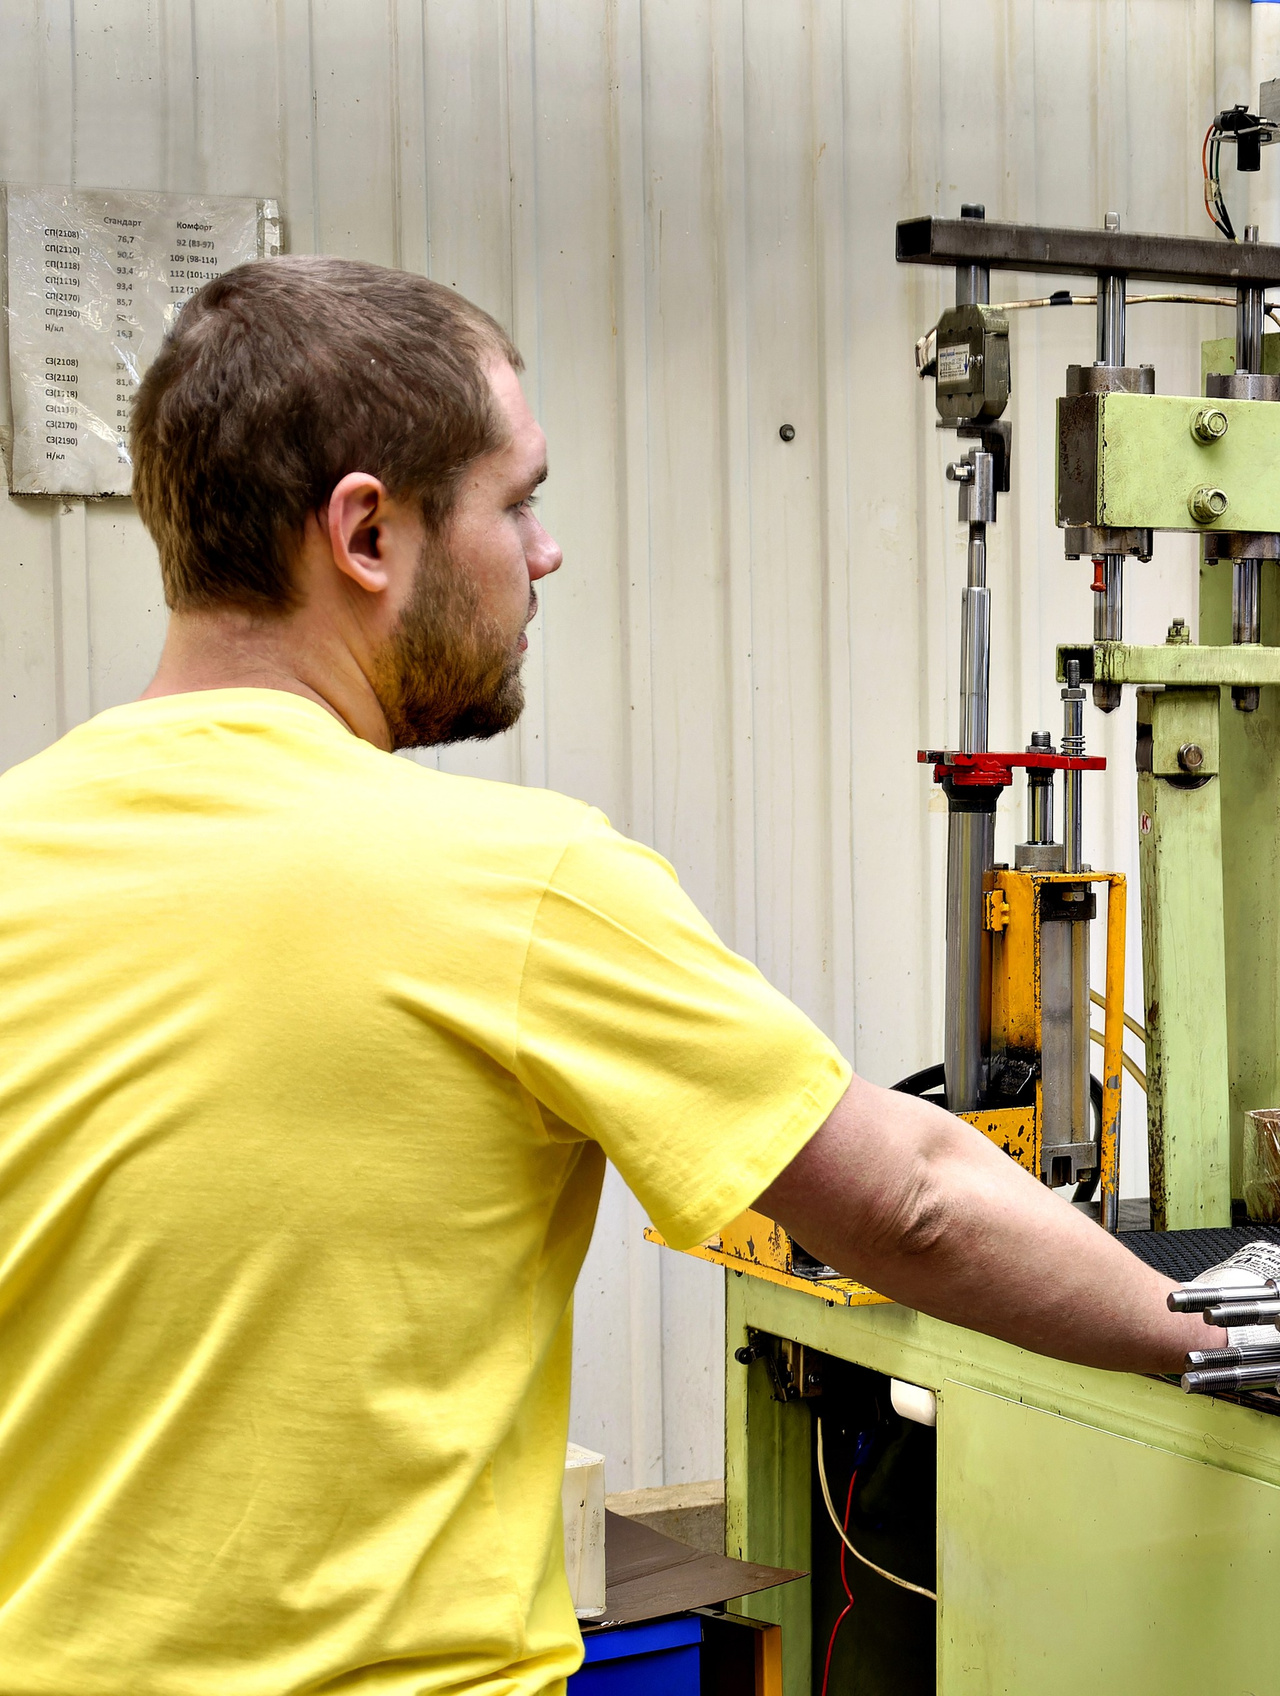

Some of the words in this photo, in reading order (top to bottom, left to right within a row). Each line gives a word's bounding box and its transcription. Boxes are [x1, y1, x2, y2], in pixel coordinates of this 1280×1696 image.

[104, 217, 142, 227] Стандарт
[176, 221, 212, 232] Комфорт
[45, 229, 79, 239] СП(2108)
[117, 235, 134, 244] 76,7
[45, 244, 80, 255] СП(2110)
[170, 254, 184, 262] 109
[187, 255, 217, 266] (98-114)
[45, 260, 80, 271] СП(1118)
[117, 266, 133, 275] 93,4
[170, 270, 184, 278] 112
[45, 276, 80, 287] СП(1119)
[116, 282, 133, 291] 93,4
[170, 286, 185, 294] 112
[45, 292, 80, 303] СП(2170)
[116, 298, 133, 306] 85,7
[45, 308, 80, 319] СП(2190)
[45, 323, 64, 332] Н/кл
[46, 452, 65, 460] Н/кл
